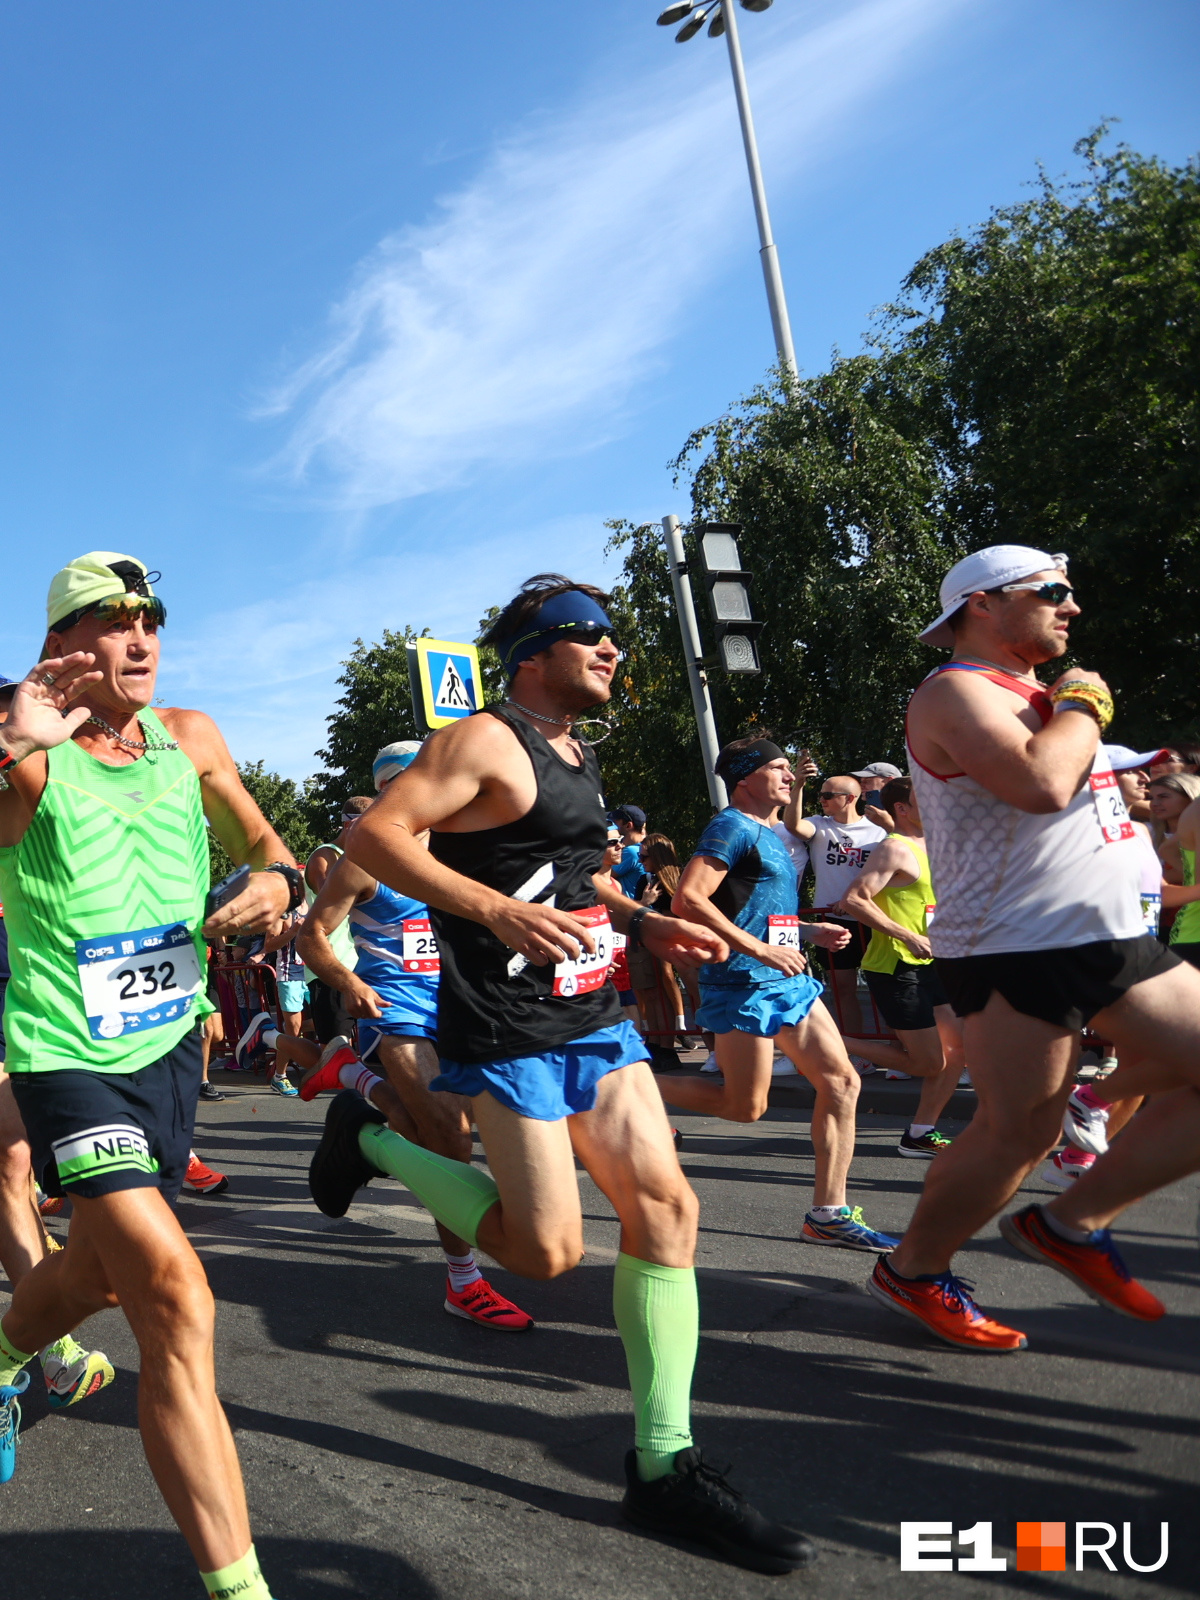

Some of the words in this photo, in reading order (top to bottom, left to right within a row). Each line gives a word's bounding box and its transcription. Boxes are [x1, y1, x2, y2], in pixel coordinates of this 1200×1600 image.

[416, 938, 439, 954] 25
[116, 961, 177, 1000] 232
[563, 978, 574, 992] A
